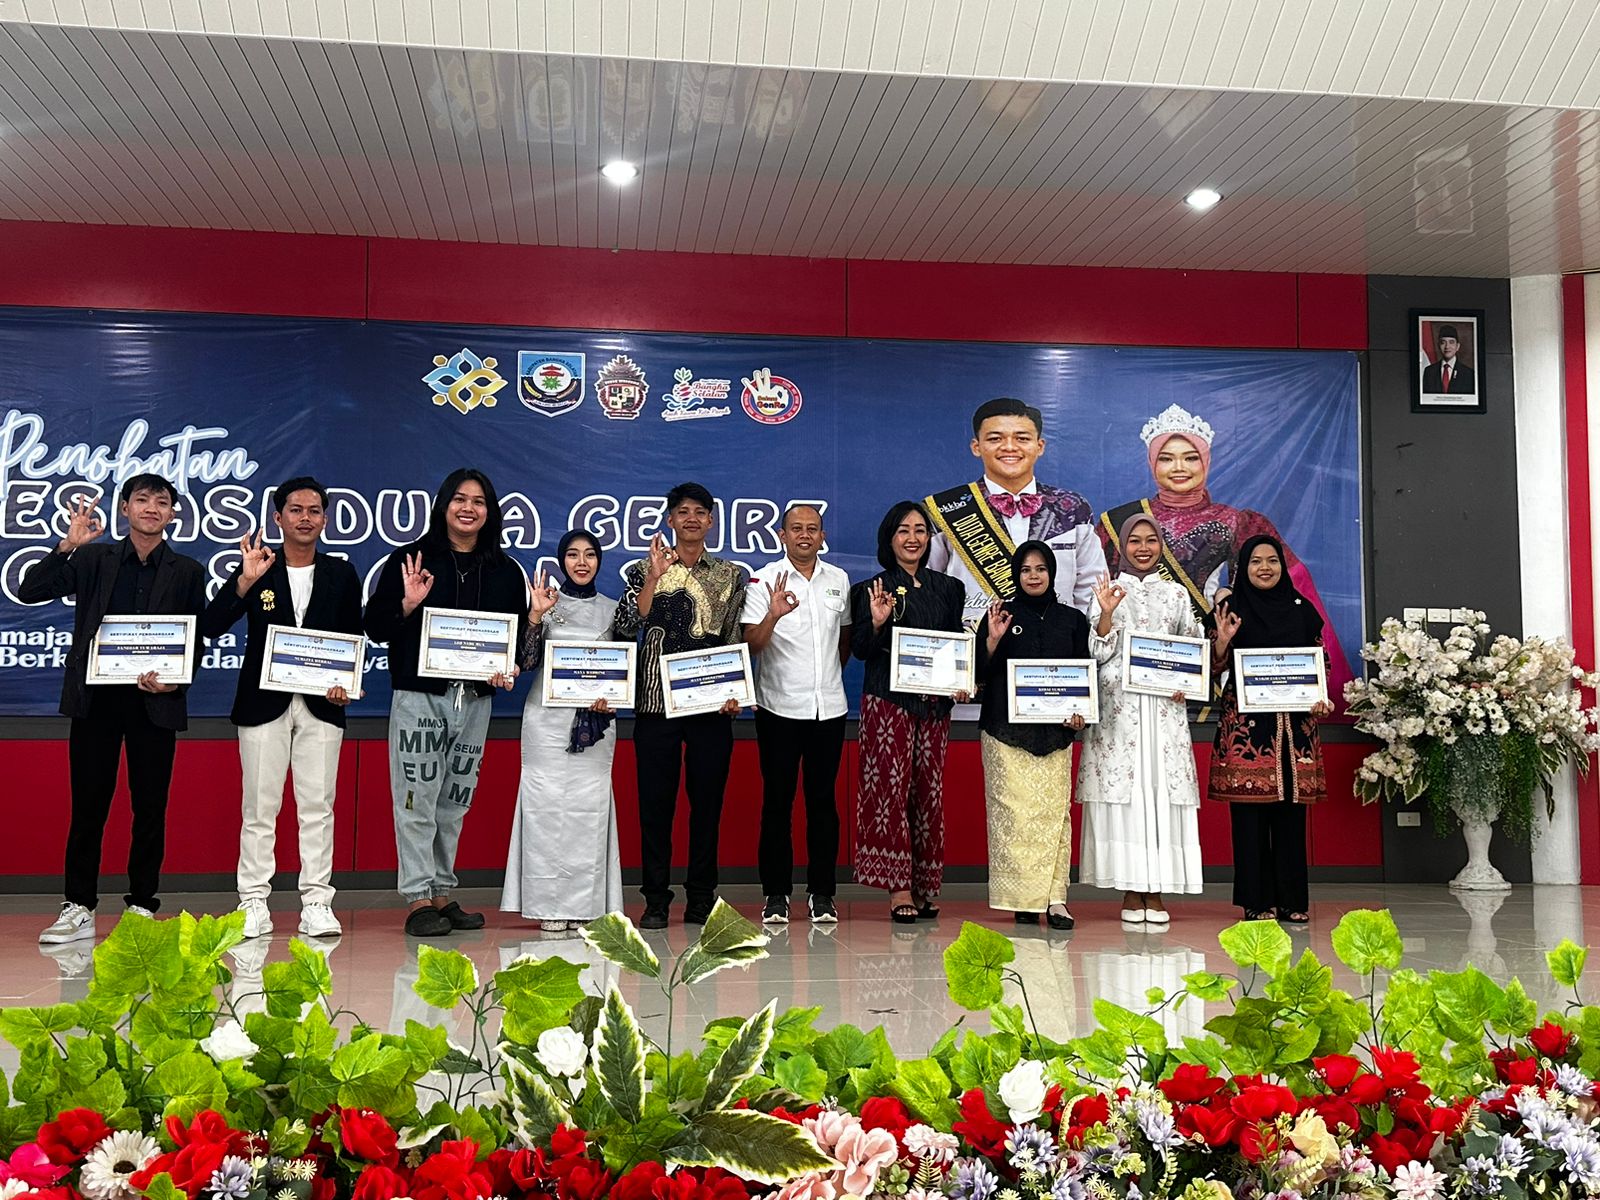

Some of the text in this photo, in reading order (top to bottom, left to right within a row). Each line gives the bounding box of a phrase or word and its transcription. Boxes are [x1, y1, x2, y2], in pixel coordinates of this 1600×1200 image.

[0, 409, 259, 499] Penobatan
[319, 486, 541, 550] DUA
[952, 512, 985, 541] DUTA
[966, 533, 1004, 566] GENRE
[403, 761, 438, 782] EU
